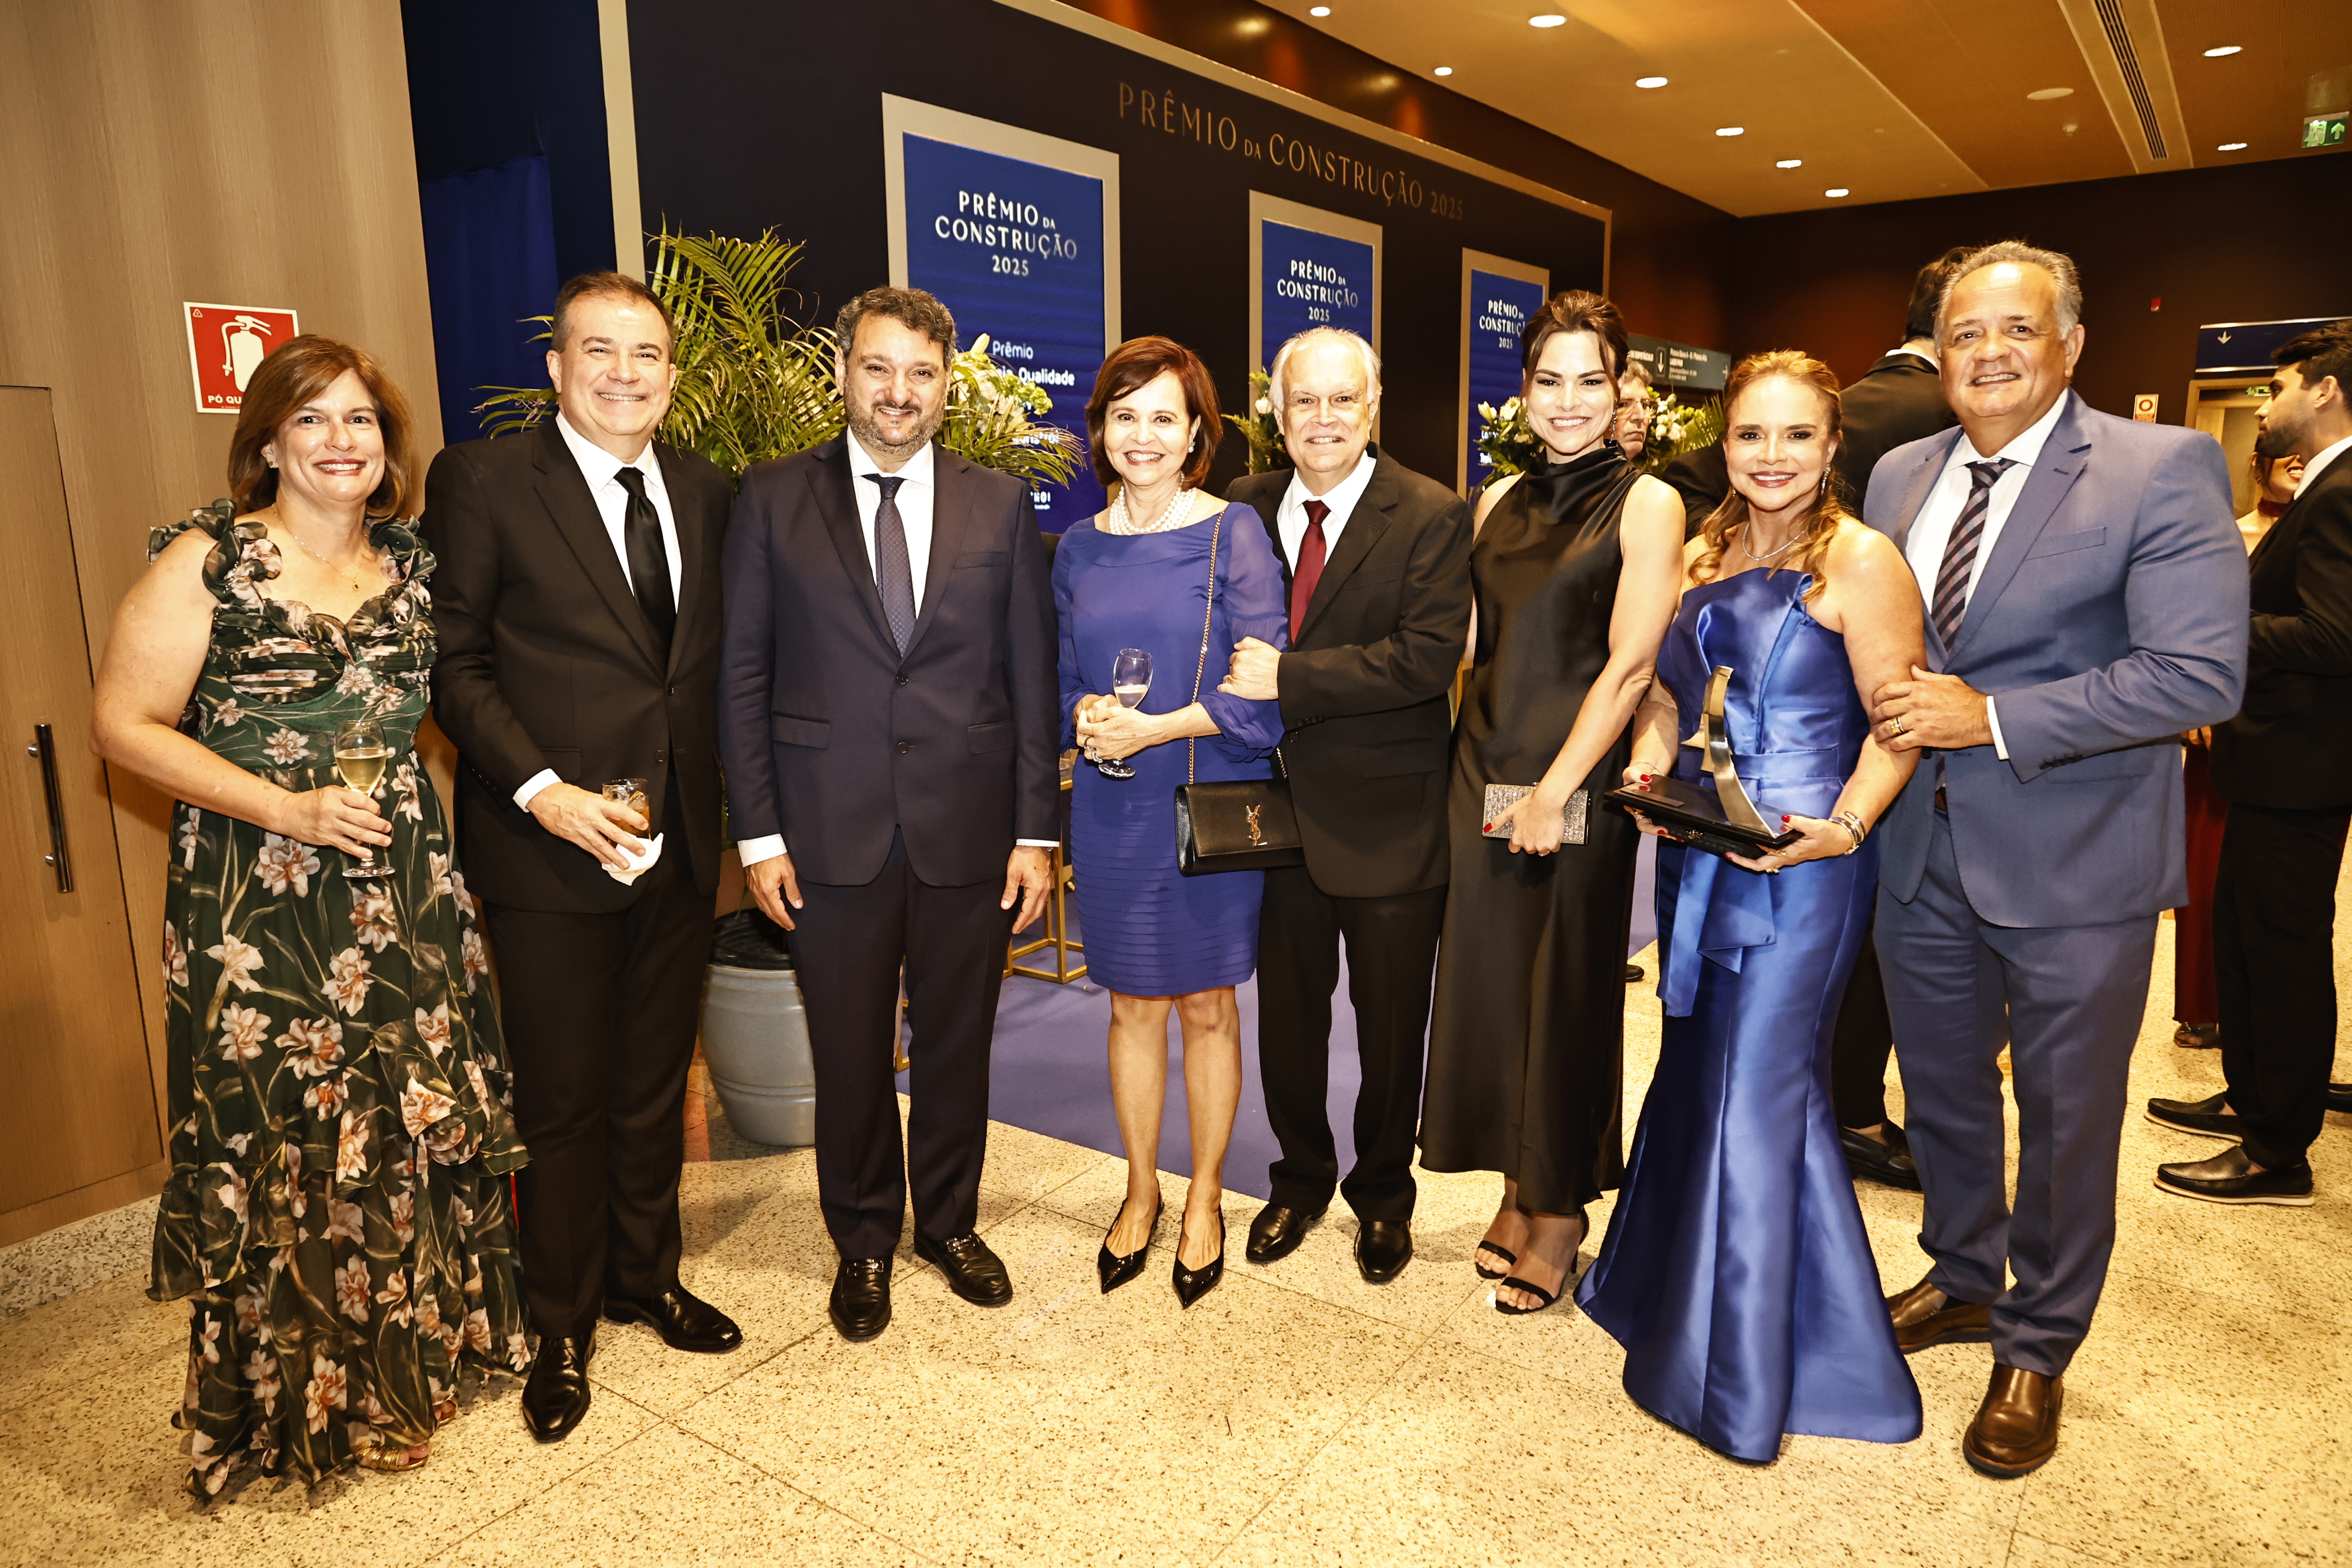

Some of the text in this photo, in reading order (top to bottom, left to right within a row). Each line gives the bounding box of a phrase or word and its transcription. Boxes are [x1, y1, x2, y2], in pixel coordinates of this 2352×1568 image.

[1120, 83, 1463, 220] PRÊMIO DA CONSTRUÇÃO 2025
[959, 190, 1056, 230] PRÊMIO DA
[935, 215, 1077, 260] CONSTRUÇÃO
[992, 254, 1029, 277] 2025
[1291, 259, 1346, 286] PRÊMIO DA
[1277, 279, 1358, 309] CONSTRUÇÃO
[1308, 306, 1329, 322] 2025
[1488, 299, 1518, 319] PRÊMIO
[1479, 315, 1525, 338] CONSTRUÇ
[992, 340, 1033, 360] Prêmio
[1499, 337, 1513, 349] 2025
[1018, 367, 1075, 386] Qualidade
[208, 394, 224, 404] PÓ
